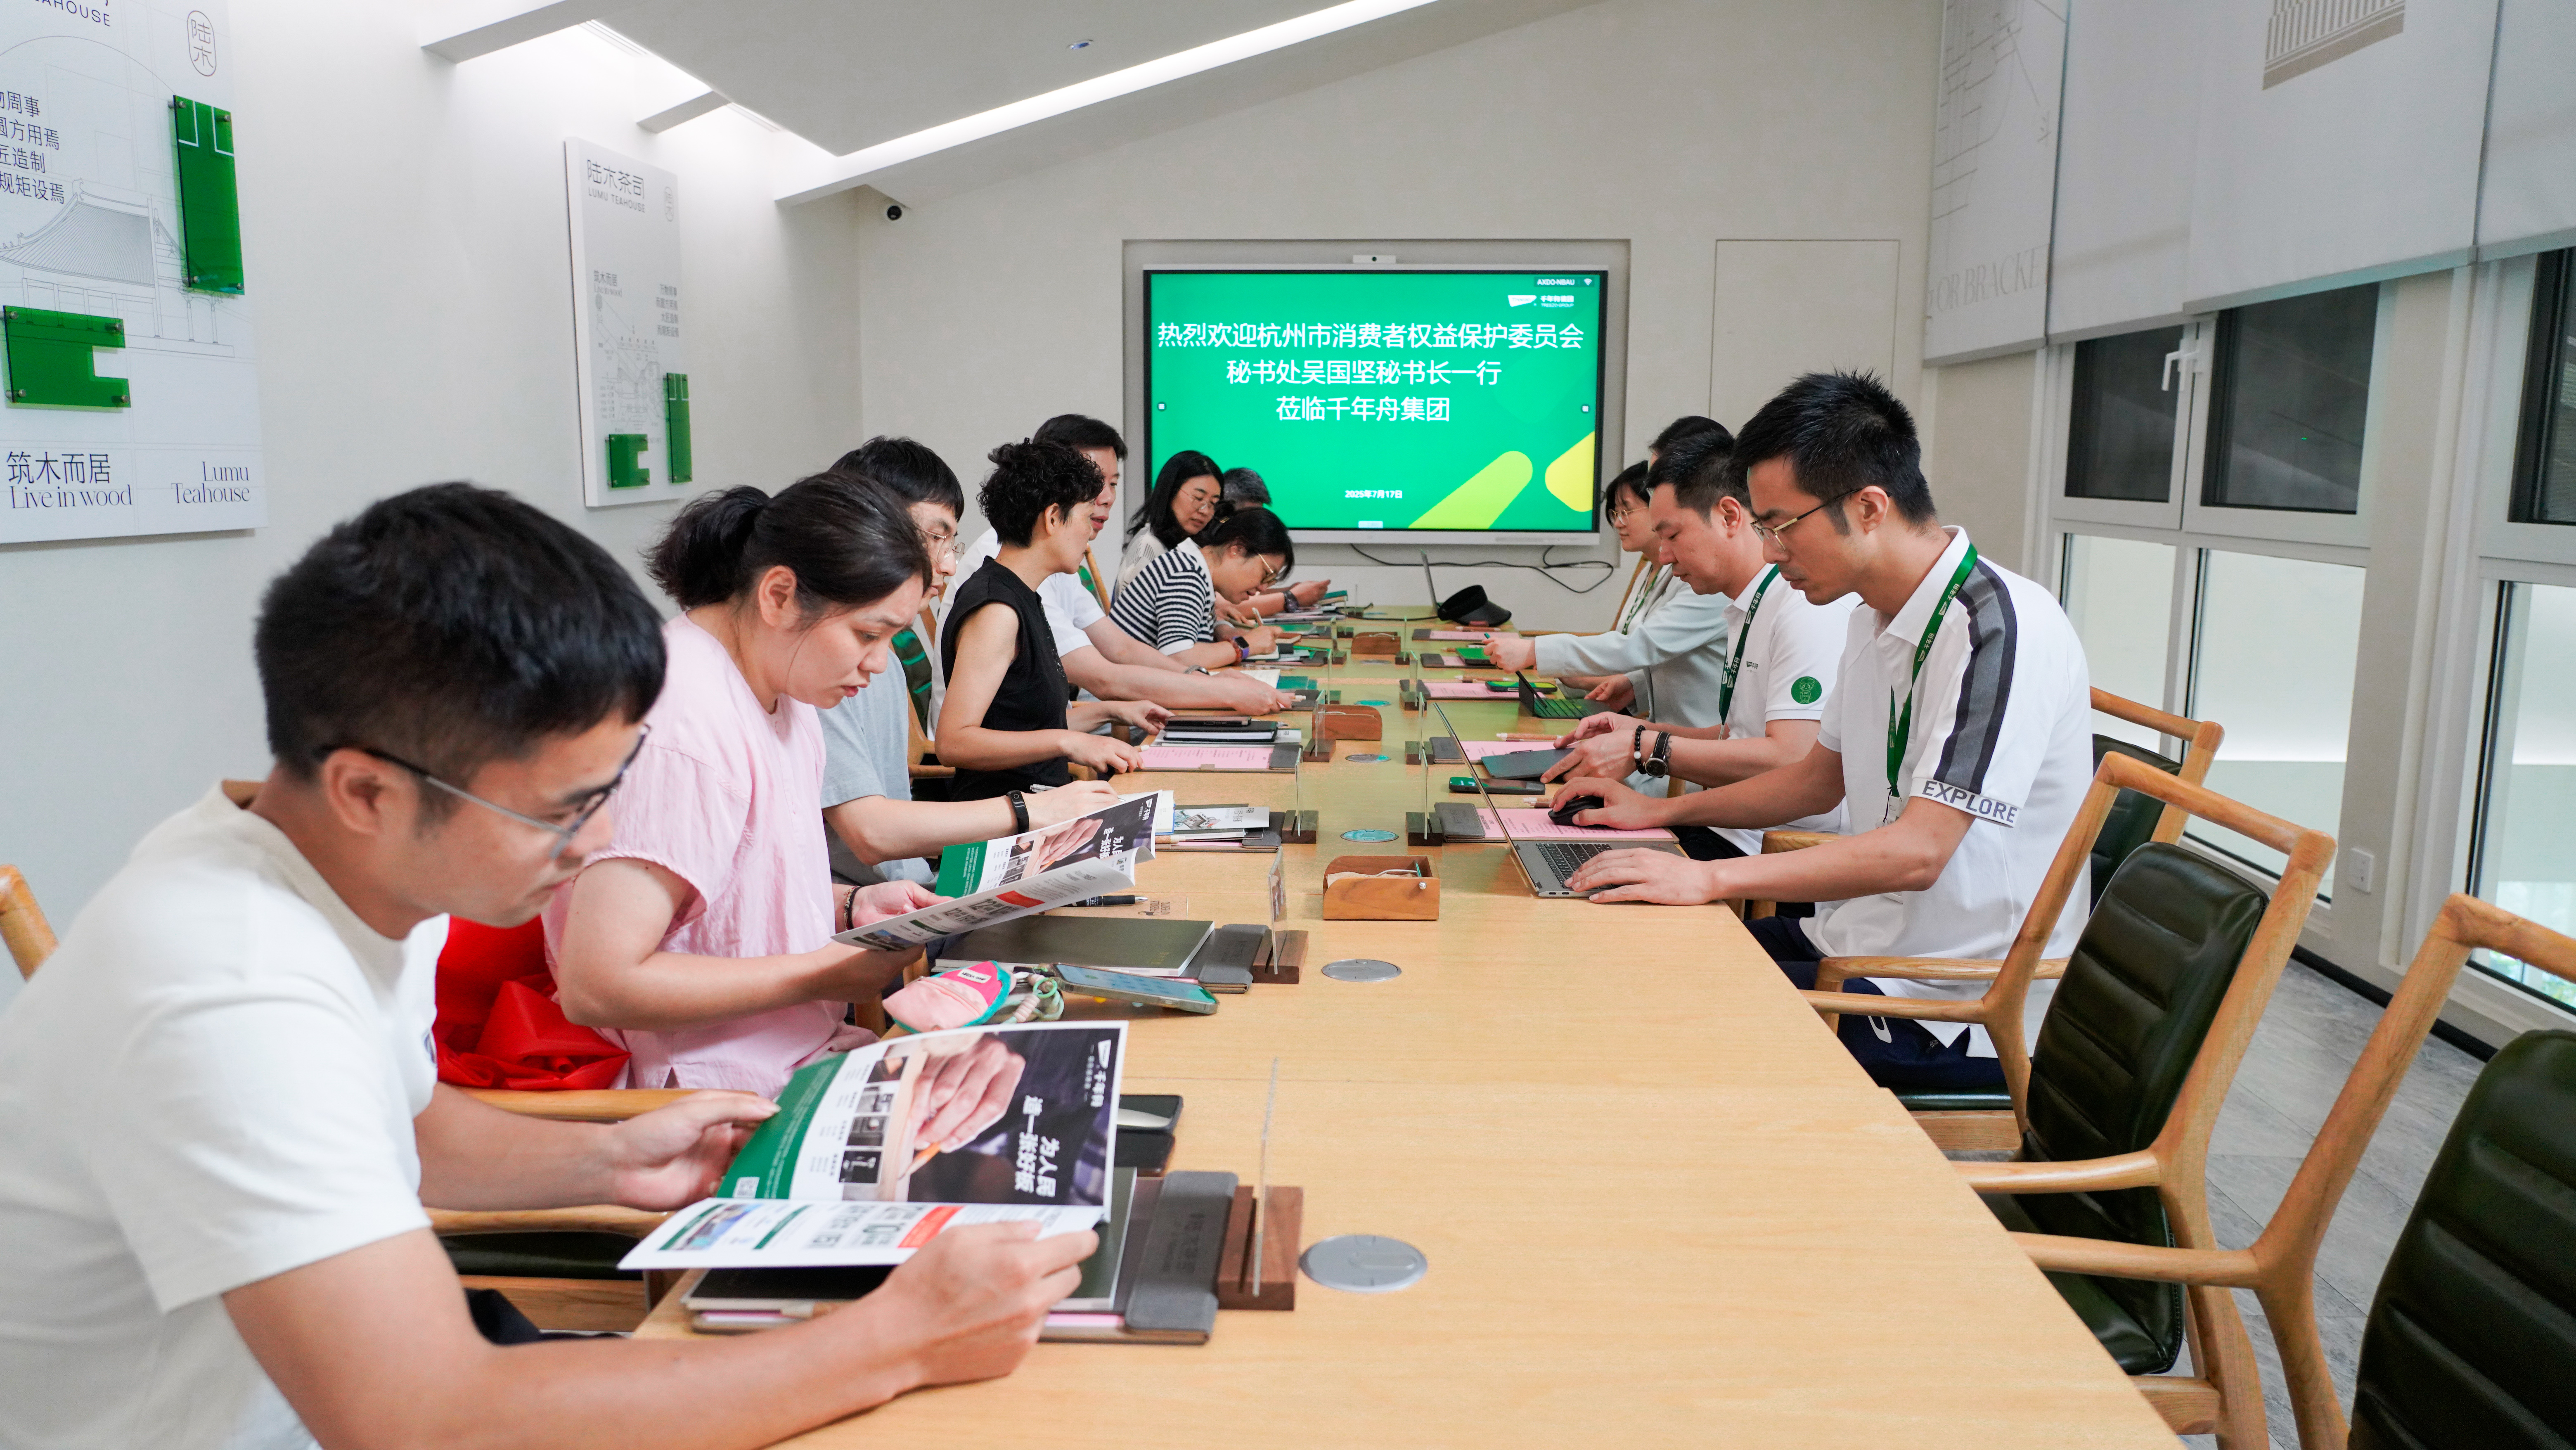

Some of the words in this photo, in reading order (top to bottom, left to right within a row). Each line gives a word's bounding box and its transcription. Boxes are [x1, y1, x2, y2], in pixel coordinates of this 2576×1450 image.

[191, 19, 214, 68] 陆木
[587, 159, 644, 199] 陆木茶司
[589, 187, 608, 201] LUMU
[611, 194, 645, 213] TEAHOUSE
[1964, 243, 2050, 306] BRACKE
[1158, 322, 1584, 349] 热烈欢迎杭州市消费者权益保护委员会
[1226, 359, 1502, 386] 秘书处吴国坚秘书长一行
[1276, 396, 1450, 422] 莅临千年舟集团
[6, 451, 111, 484] 筑木而居
[201, 461, 249, 482] Lumu
[11, 486, 53, 509] Live
[57, 486, 76, 507] in
[81, 484, 132, 506] wood
[171, 482, 251, 504] Teahouse
[1345, 490, 1403, 499] 2025年7月17日
[1751, 592, 1762, 610] 千年舟
[1947, 583, 1960, 601] 千年舟
[1924, 633, 1935, 649] 千年舟
[1731, 656, 1740, 674] 千年舟
[1922, 780, 2018, 824] EXPLORE
[1015, 1095, 1045, 1194] 造一张好板
[1036, 1137, 1060, 1197] 为人民
